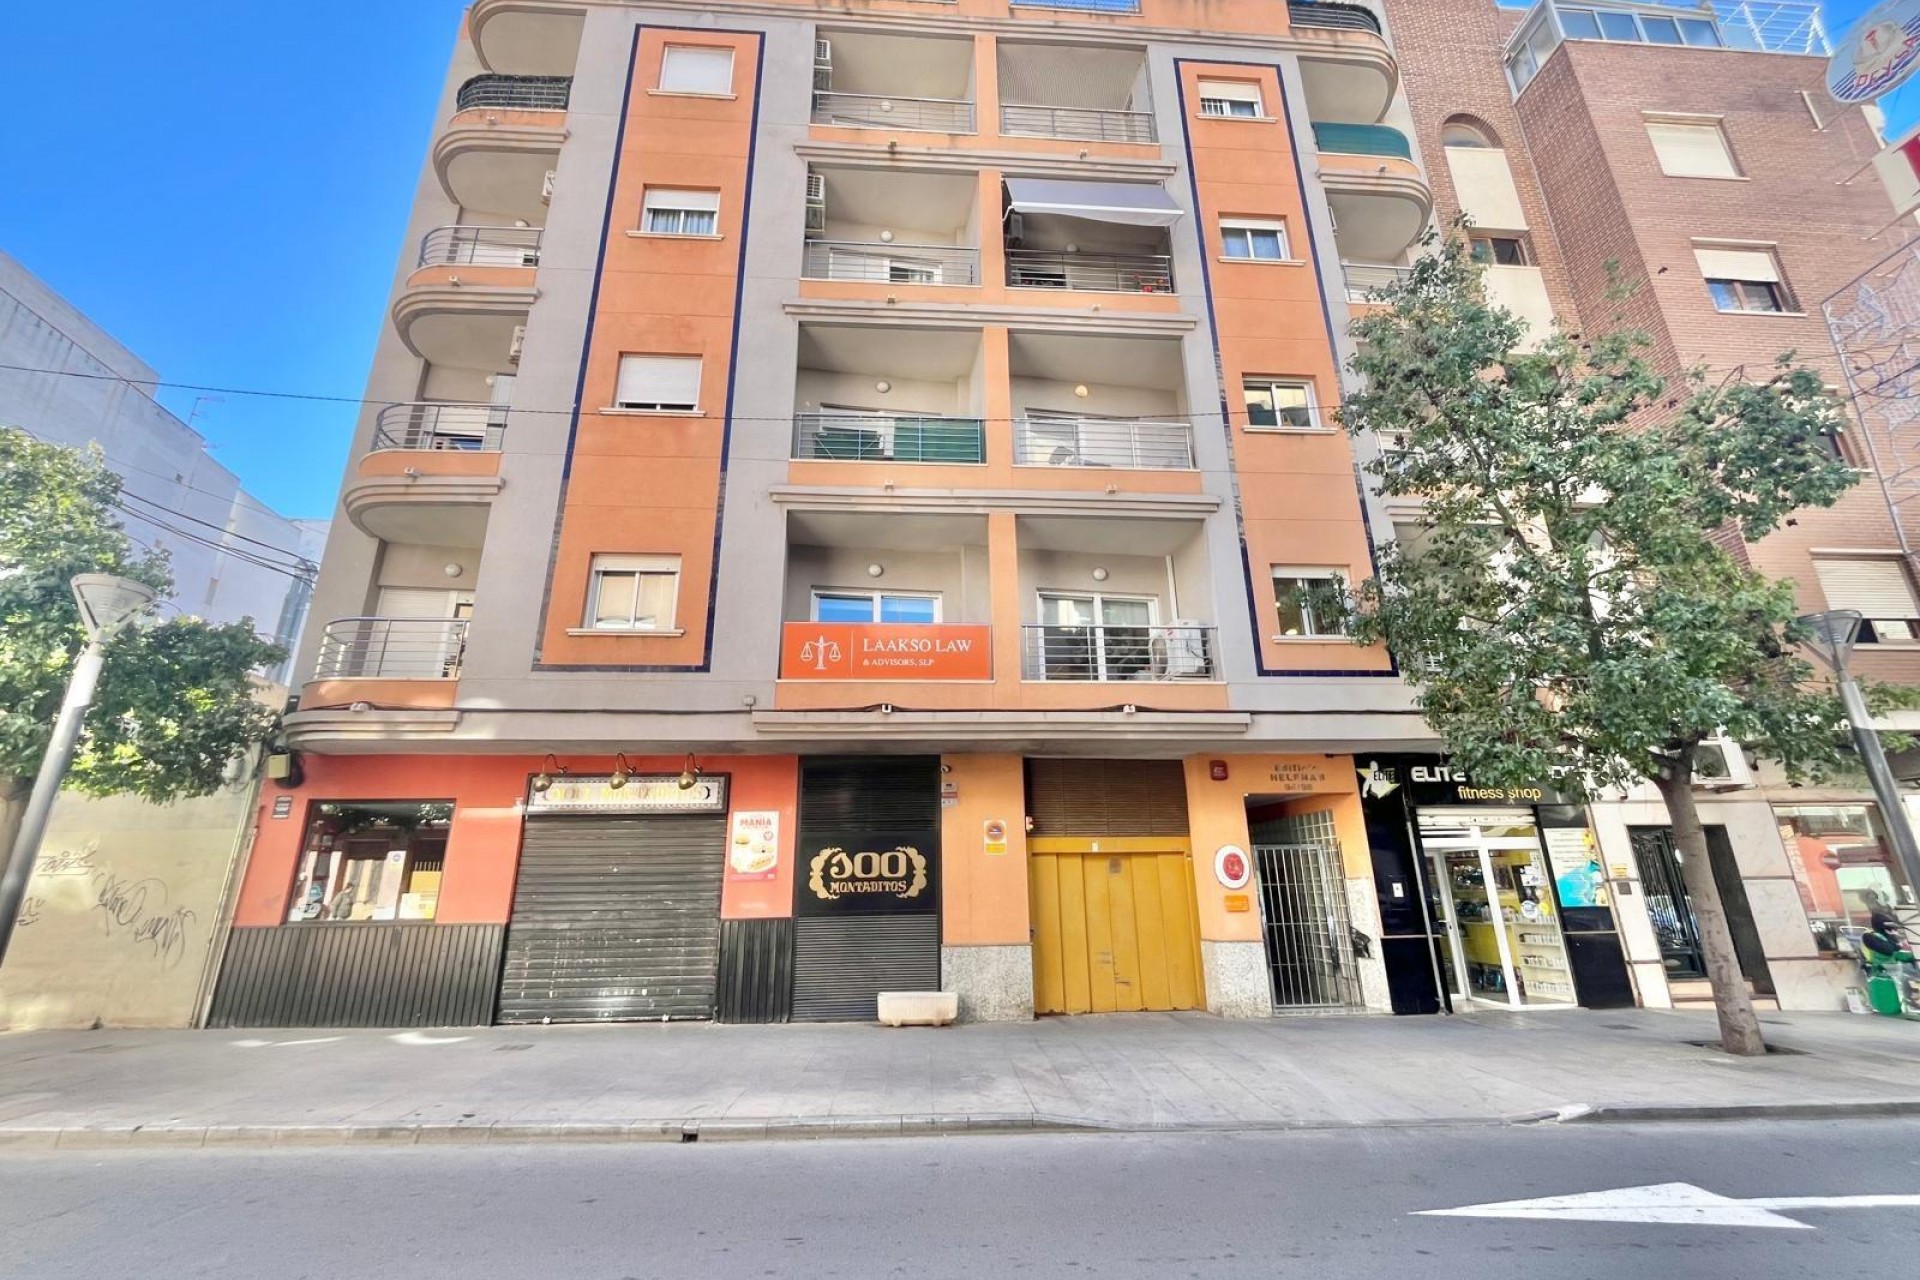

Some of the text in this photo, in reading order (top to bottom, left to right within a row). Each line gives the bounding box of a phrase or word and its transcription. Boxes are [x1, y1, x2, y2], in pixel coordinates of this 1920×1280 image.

[863, 638, 972, 653] LAAKSO LAW
[1457, 786, 1542, 801] fitness shop
[829, 880, 907, 893] MONTADITOS
